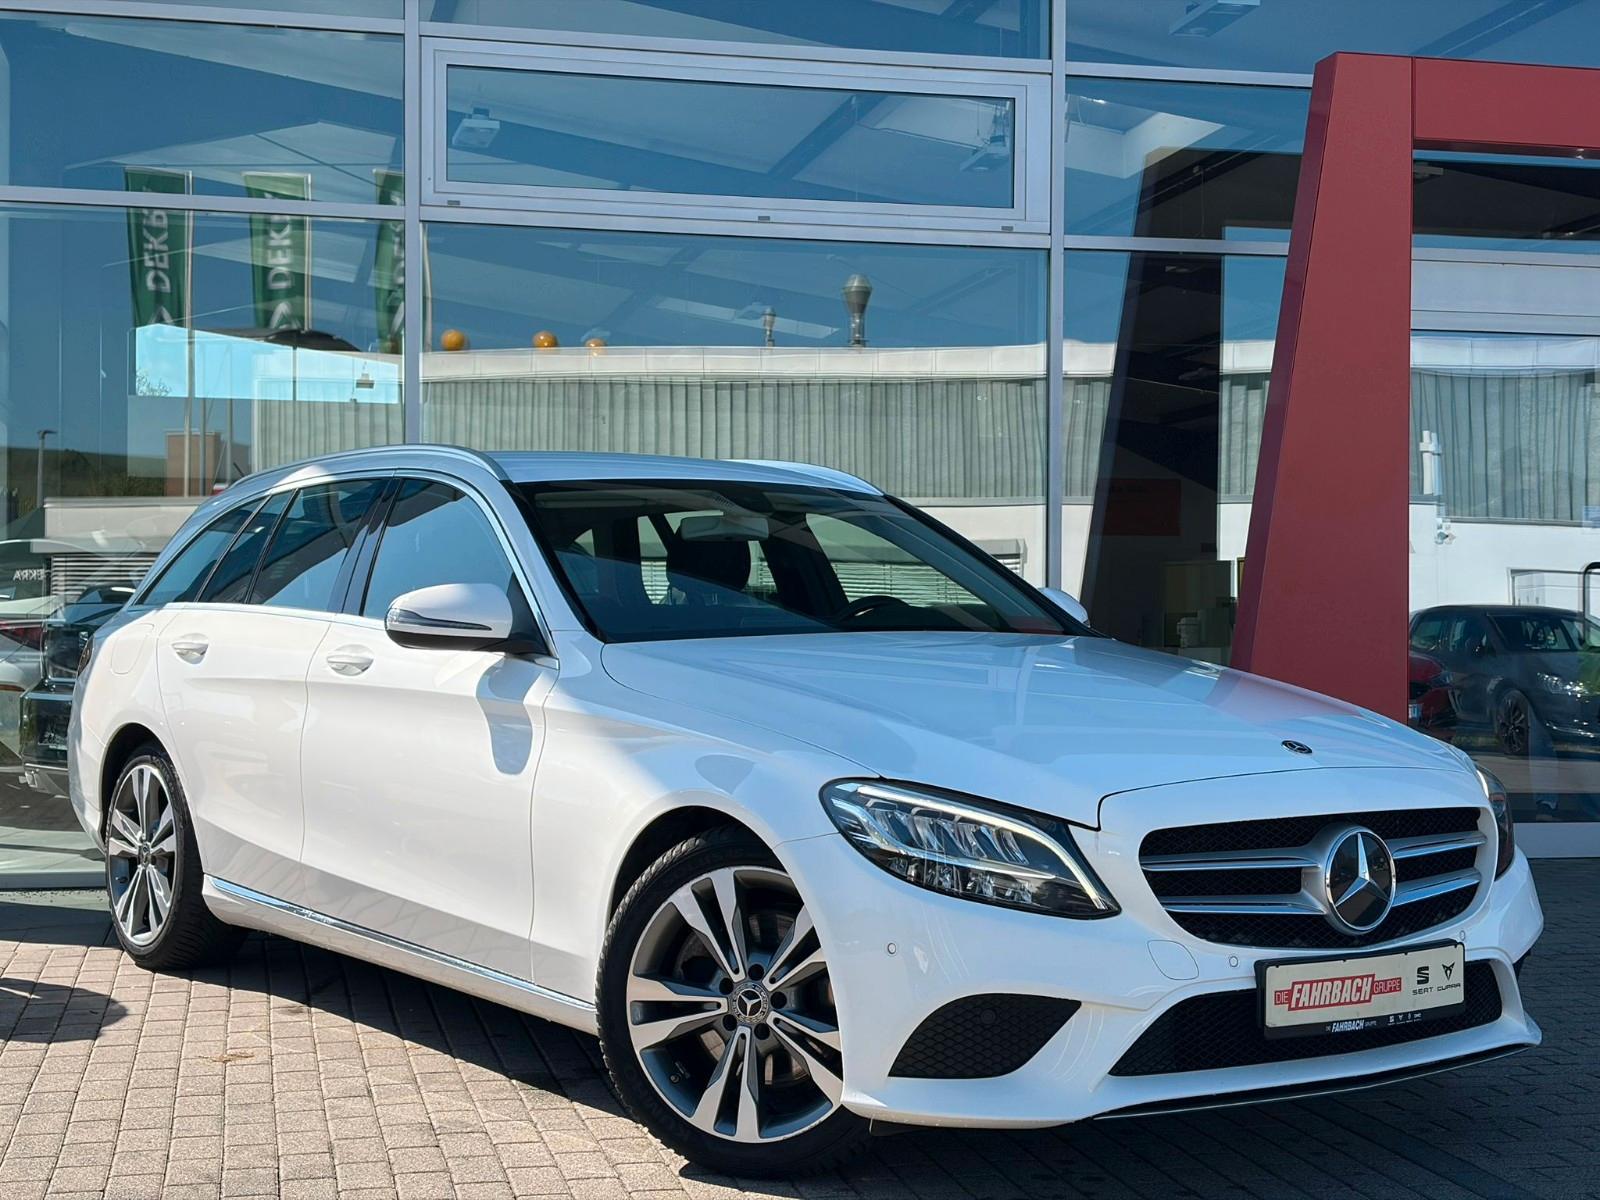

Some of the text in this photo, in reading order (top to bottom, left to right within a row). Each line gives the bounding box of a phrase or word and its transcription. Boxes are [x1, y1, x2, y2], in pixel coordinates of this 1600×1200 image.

[1275, 976, 1401, 1008] DIE FAHRBACH GRUPPE
[1412, 986, 1434, 996] SEAT
[1331, 1020, 1365, 1033] FAHRBACH
